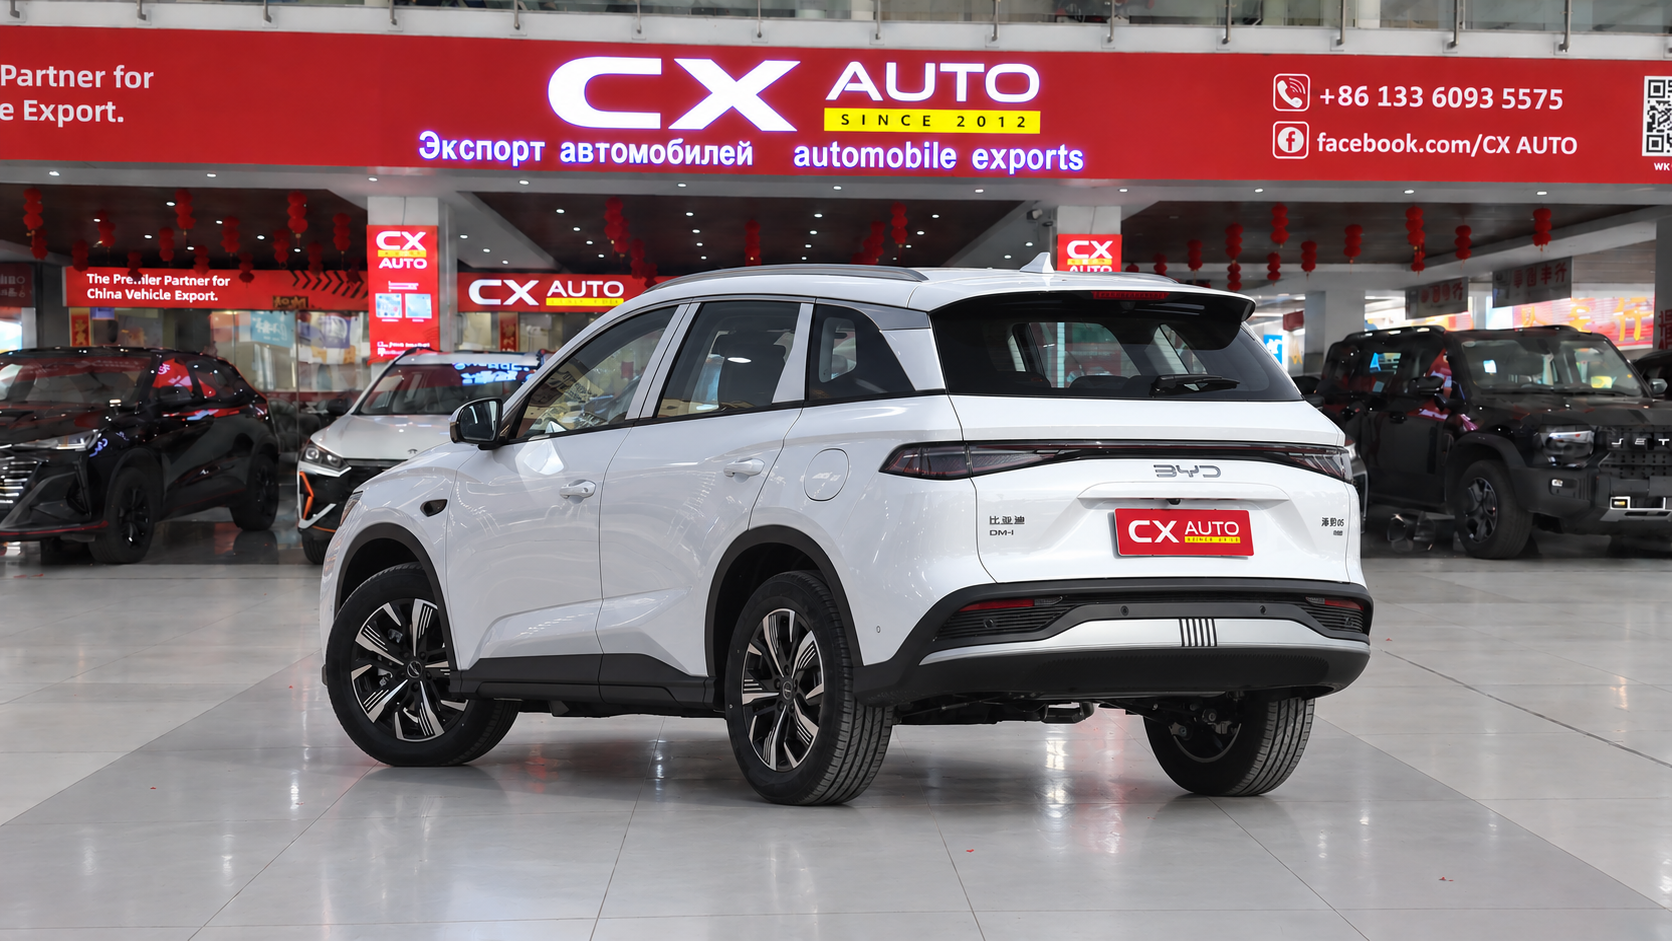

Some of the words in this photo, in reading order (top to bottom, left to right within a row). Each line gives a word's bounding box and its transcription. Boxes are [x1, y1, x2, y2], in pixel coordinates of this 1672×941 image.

[0, 64, 106, 88] Partner
[113, 64, 155, 89] for
[547, 56, 802, 131] CX
[825, 61, 1041, 103] AUTO
[1319, 85, 1369, 107] +86
[1377, 85, 1424, 108] 133
[1431, 86, 1495, 109] 6093
[1501, 87, 1564, 110] 5575
[23, 99, 124, 128] Export.
[841, 113, 932, 127] SINCE
[956, 115, 1027, 128] 2012
[418, 130, 547, 168] Экспорт
[559, 138, 754, 166] автомобилей
[1316, 131, 1511, 158] facebook.com/CX
[1515, 136, 1579, 155] AUTO
[793, 140, 957, 169] automobile
[971, 143, 1085, 175] exports
[375, 230, 427, 251] CX
[1066, 239, 1114, 259] CX
[378, 257, 428, 270] AUTO
[86, 273, 111, 285] The
[164, 275, 210, 287] Partner
[211, 275, 231, 287] for
[468, 279, 540, 306] CX
[546, 280, 625, 298] AUTO
[86, 288, 123, 300] China
[124, 288, 172, 301] Vehicle
[174, 289, 219, 304] Export.
[1153, 464, 1222, 478] BYD
[1128, 519, 1180, 544] CX
[1184, 520, 1240, 536] AUTO
